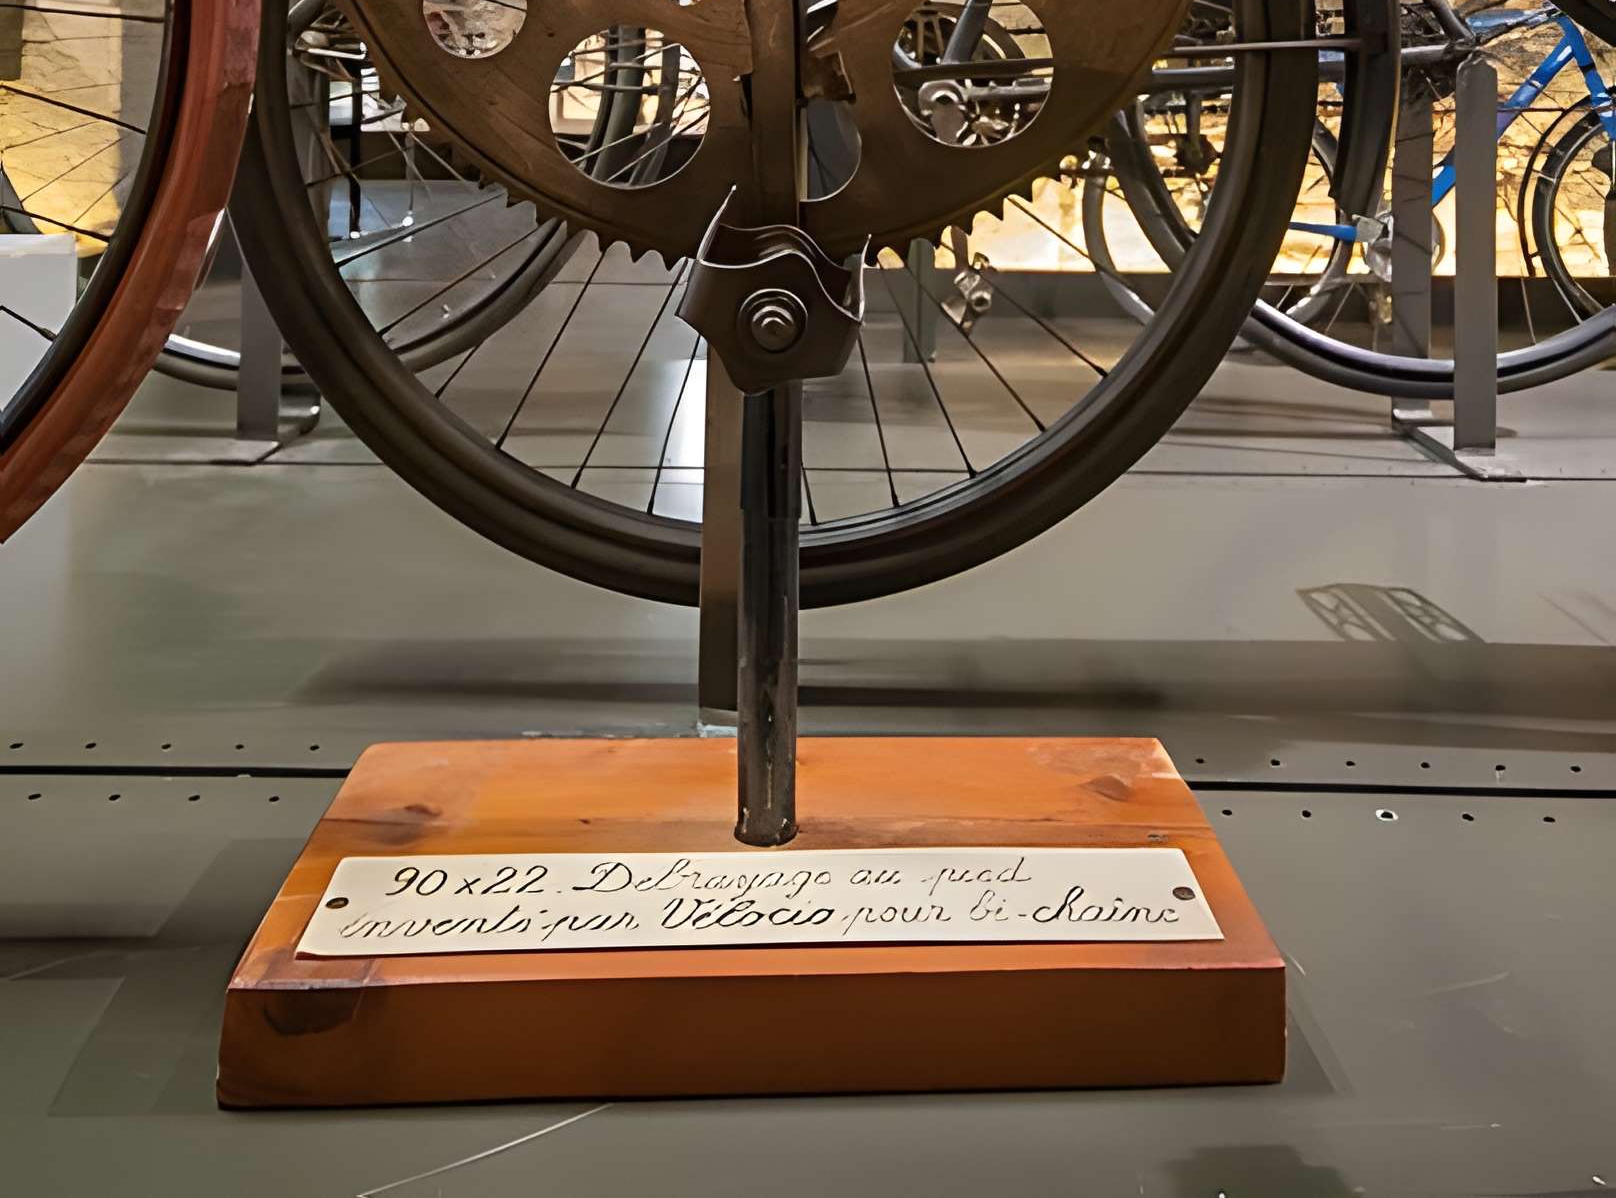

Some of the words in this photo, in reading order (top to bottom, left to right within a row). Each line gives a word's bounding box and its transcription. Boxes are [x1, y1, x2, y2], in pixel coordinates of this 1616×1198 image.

[850, 868, 901, 885] au
[541, 912, 640, 942] par
[840, 904, 951, 936] pour
